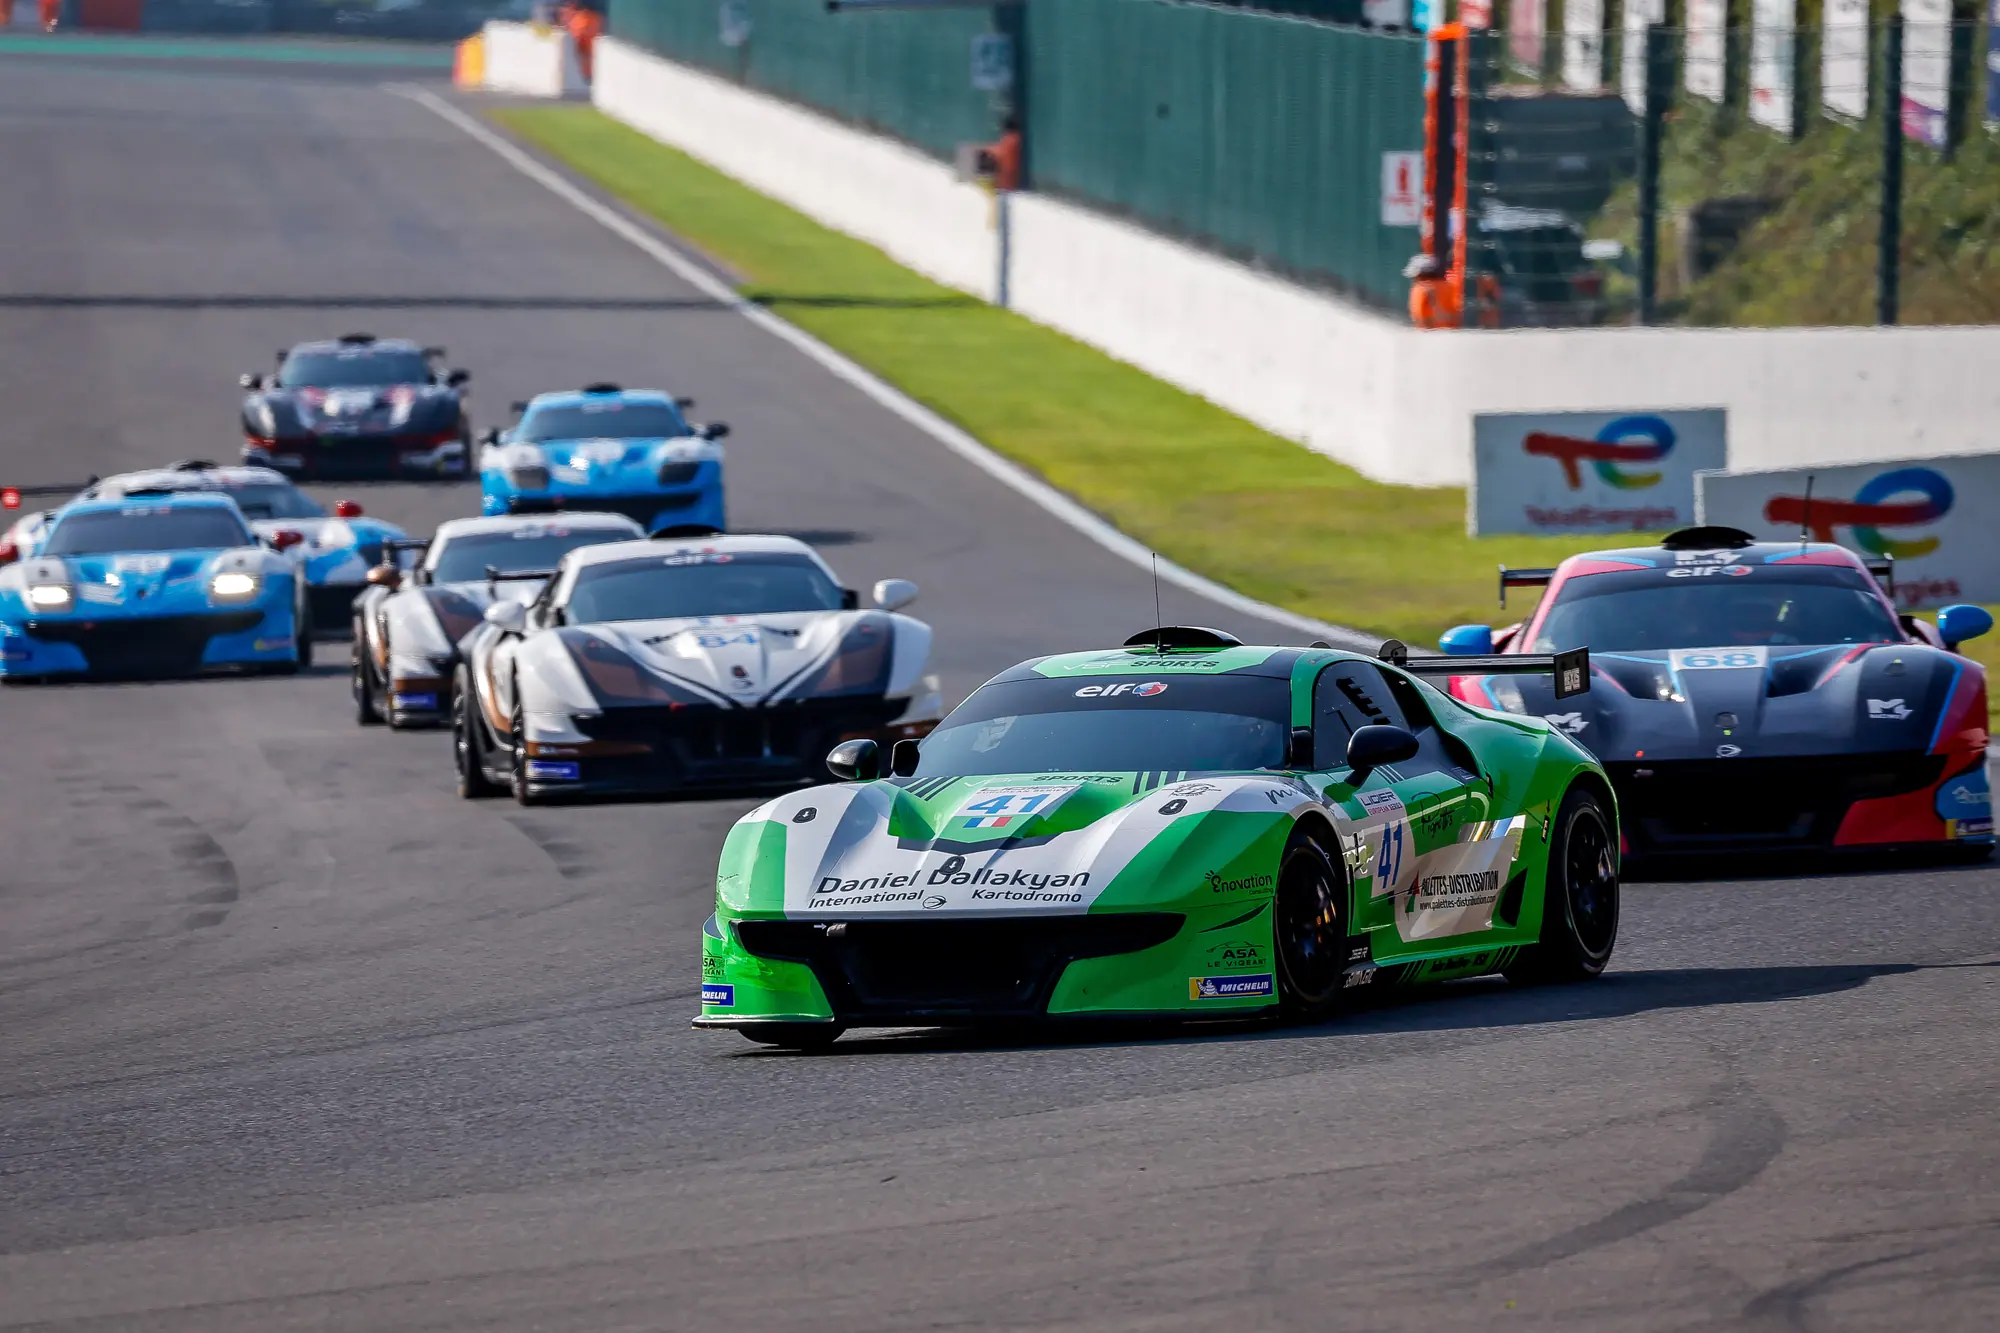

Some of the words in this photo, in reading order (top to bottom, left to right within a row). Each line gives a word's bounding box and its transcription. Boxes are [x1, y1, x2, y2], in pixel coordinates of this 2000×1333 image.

[1665, 567, 1722, 578] elf
[1130, 659, 1220, 669] SPORTS
[1682, 653, 1758, 668] 68
[1074, 682, 1137, 698] elf
[1034, 775, 1124, 784] SPORTS
[967, 793, 1051, 815] 41
[1377, 821, 1404, 889] 41
[816, 870, 922, 894] Daniel
[926, 869, 1091, 890] Dallakyan
[808, 890, 925, 909] International
[971, 889, 1083, 903] Kartodromo
[1222, 948, 1258, 960] ASA
[1219, 981, 1269, 992] MICHELIN
